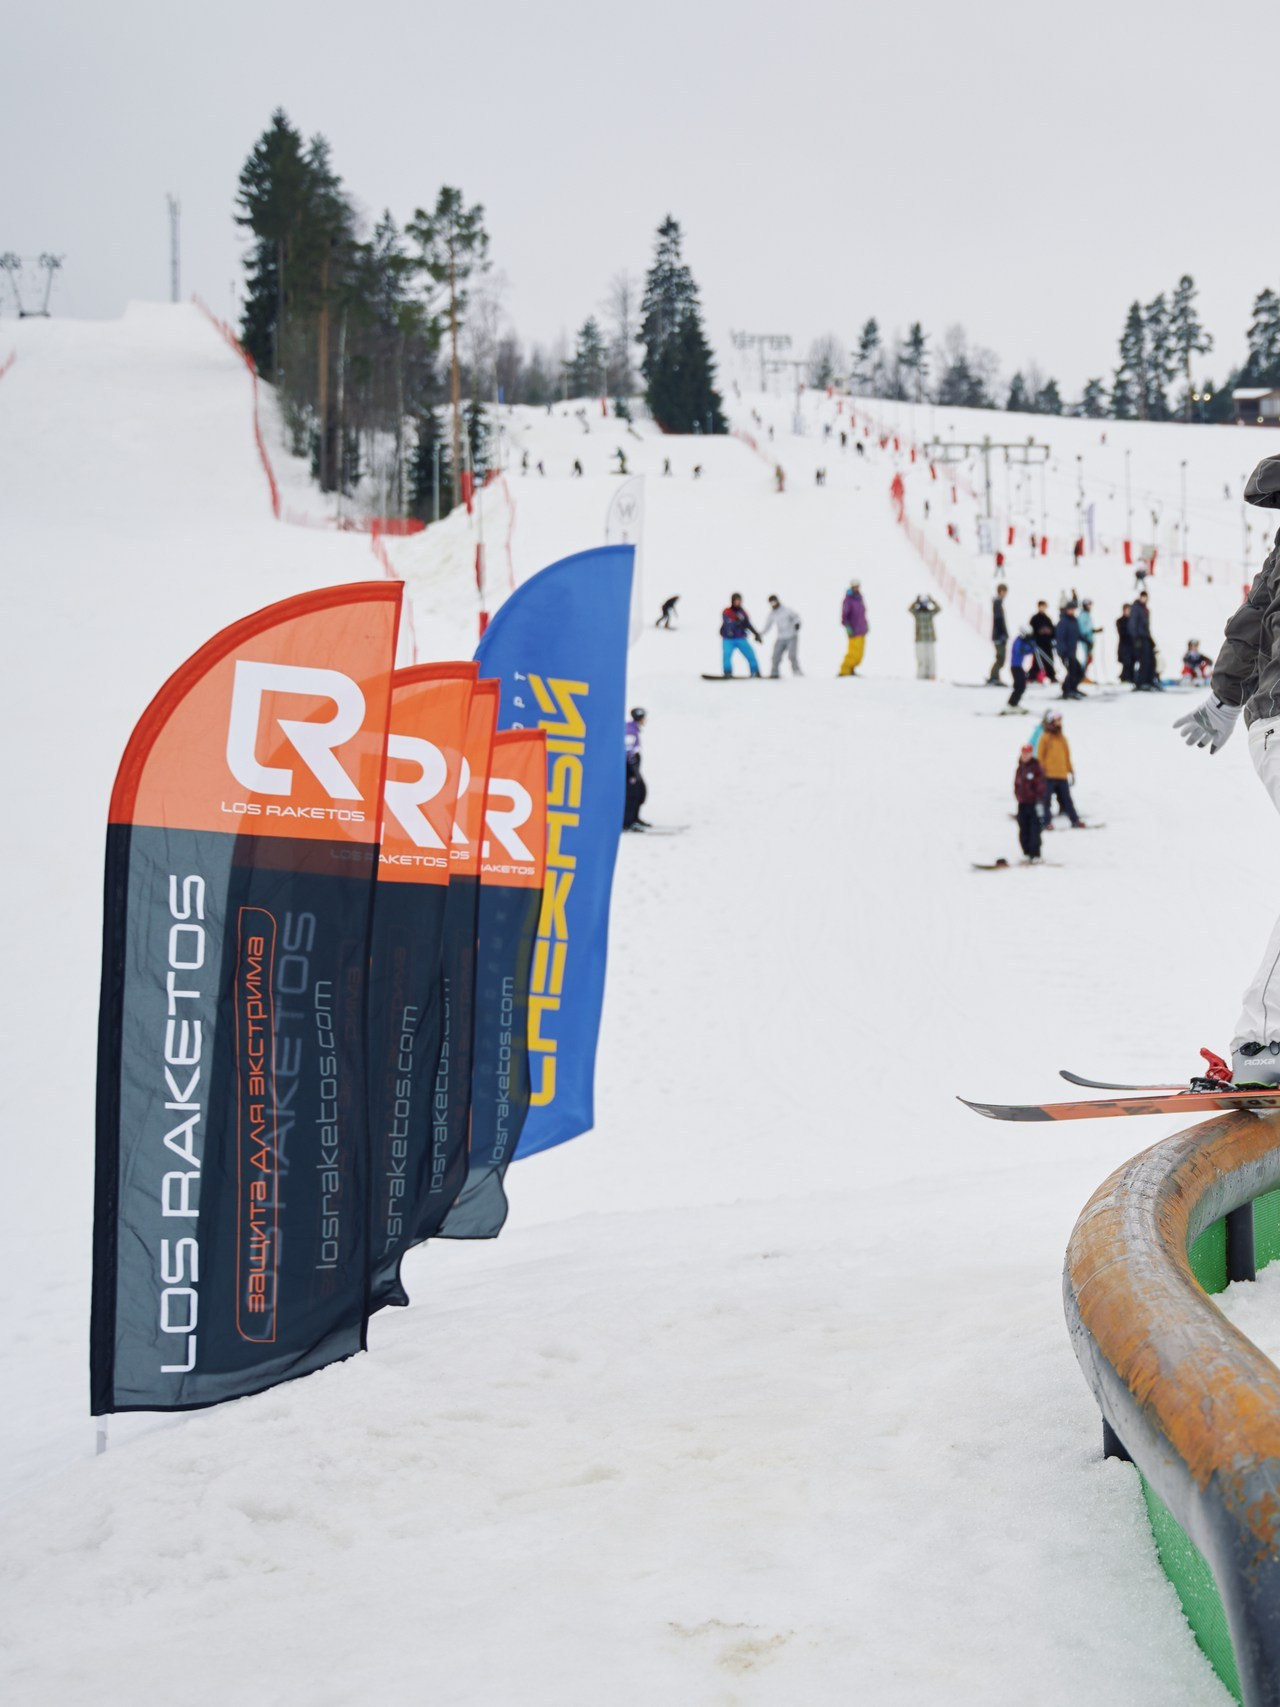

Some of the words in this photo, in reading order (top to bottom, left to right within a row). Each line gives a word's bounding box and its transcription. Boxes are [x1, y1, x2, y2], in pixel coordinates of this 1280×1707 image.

[220, 801, 262, 816] LOS
[265, 805, 366, 823] RAKETOS
[162, 874, 206, 1217] RAKETOS
[315, 980, 339, 1269] losraketos.com
[488, 976, 514, 1165] losraketos.com
[160, 1237, 200, 1373] LOS
